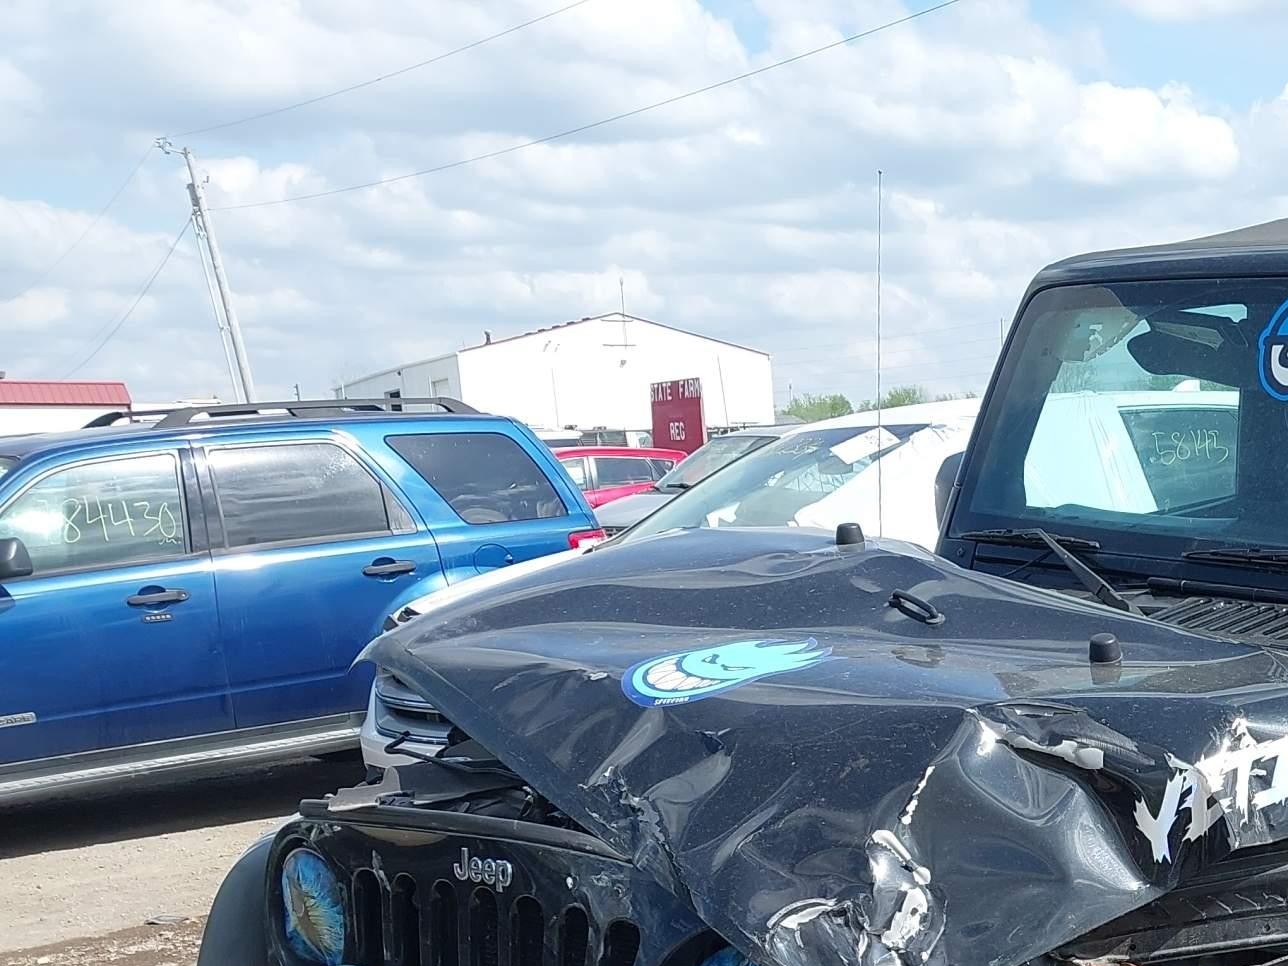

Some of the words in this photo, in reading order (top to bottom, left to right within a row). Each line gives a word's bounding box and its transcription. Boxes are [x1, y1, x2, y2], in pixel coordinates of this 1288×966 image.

[650, 382, 673, 402] STATE
[679, 379, 701, 400] FARM
[63, 496, 177, 543] 84430
[453, 847, 513, 893] Jeep
